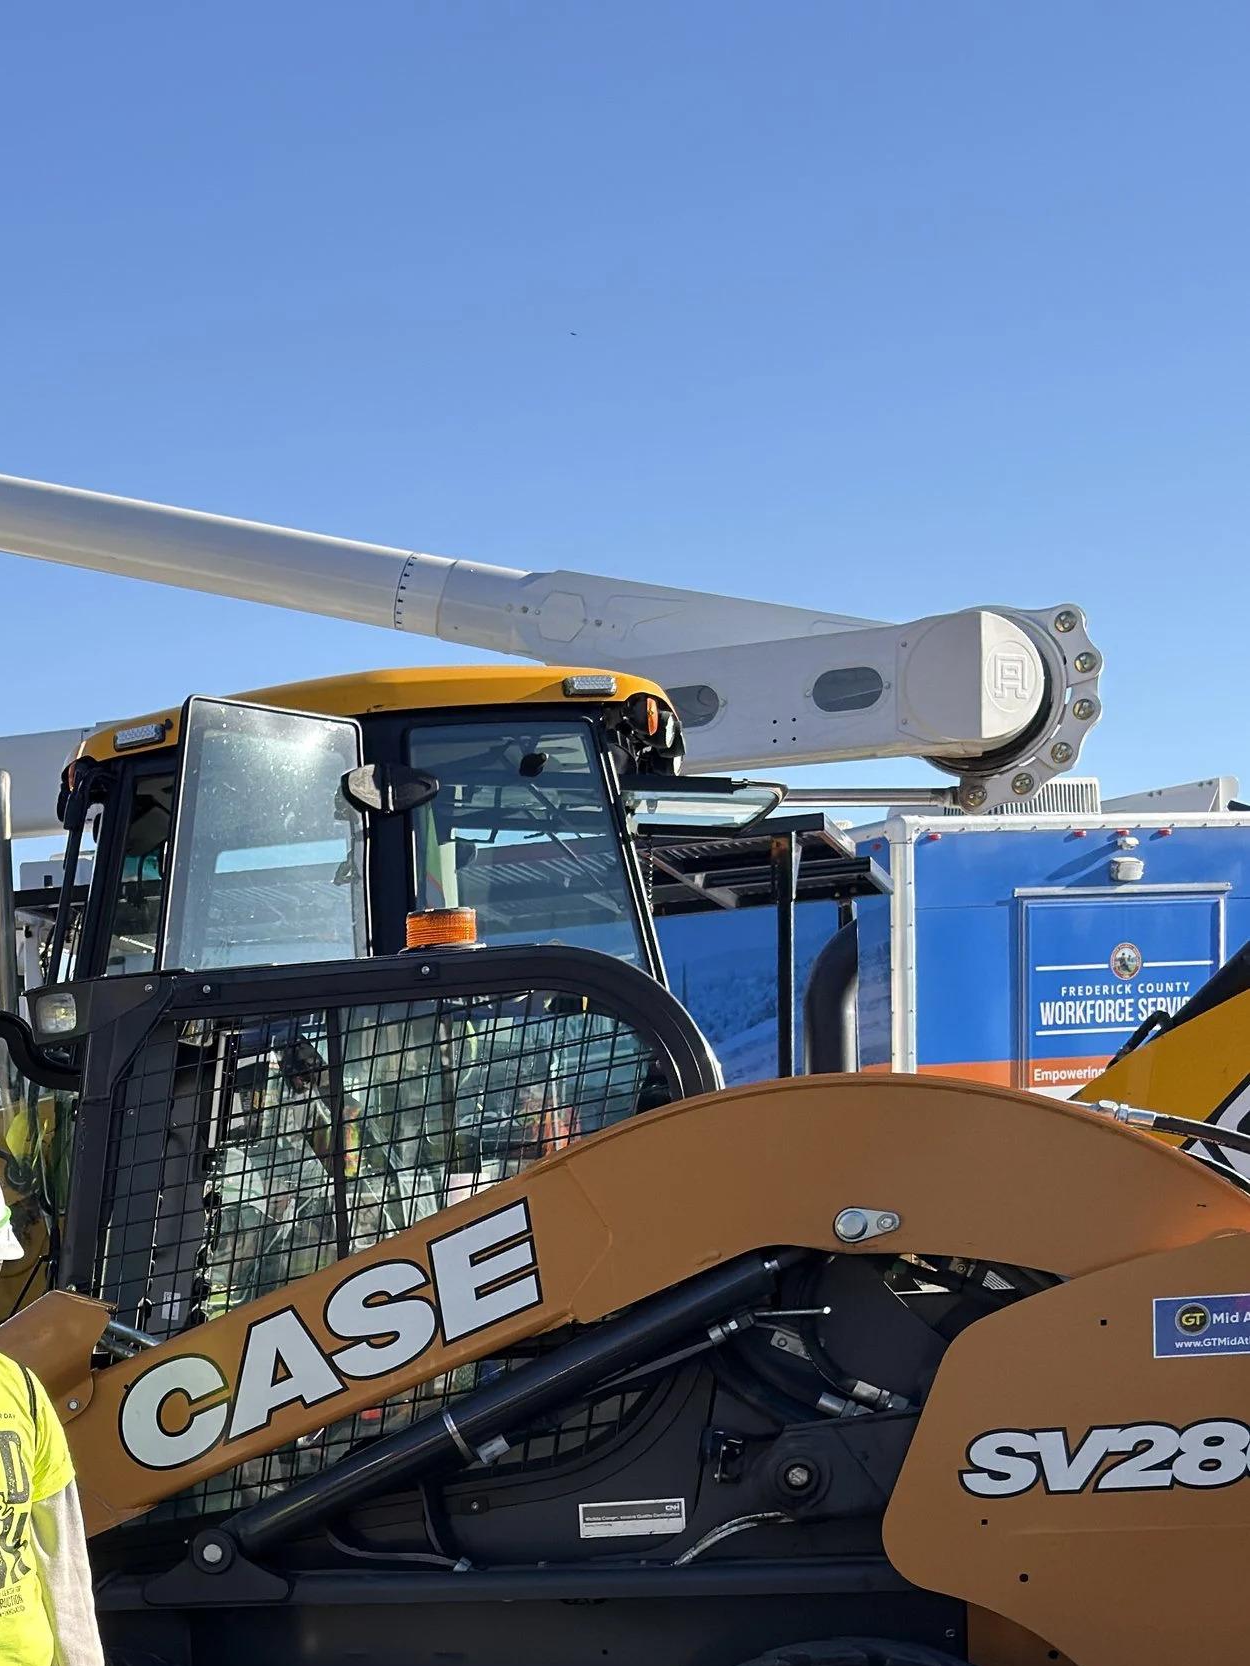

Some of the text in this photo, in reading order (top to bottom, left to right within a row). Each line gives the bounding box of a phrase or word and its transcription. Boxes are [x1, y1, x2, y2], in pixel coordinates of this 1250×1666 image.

[1061, 981, 1190, 997] FREDERICK COUNTY
[1040, 997, 1135, 1026] WORKFORCE
[118, 1195, 543, 1471] CASE
[1181, 1312, 1205, 1326] GT
[1212, 1311, 1239, 1325] Mid
[958, 1416, 1250, 1499] SV28
